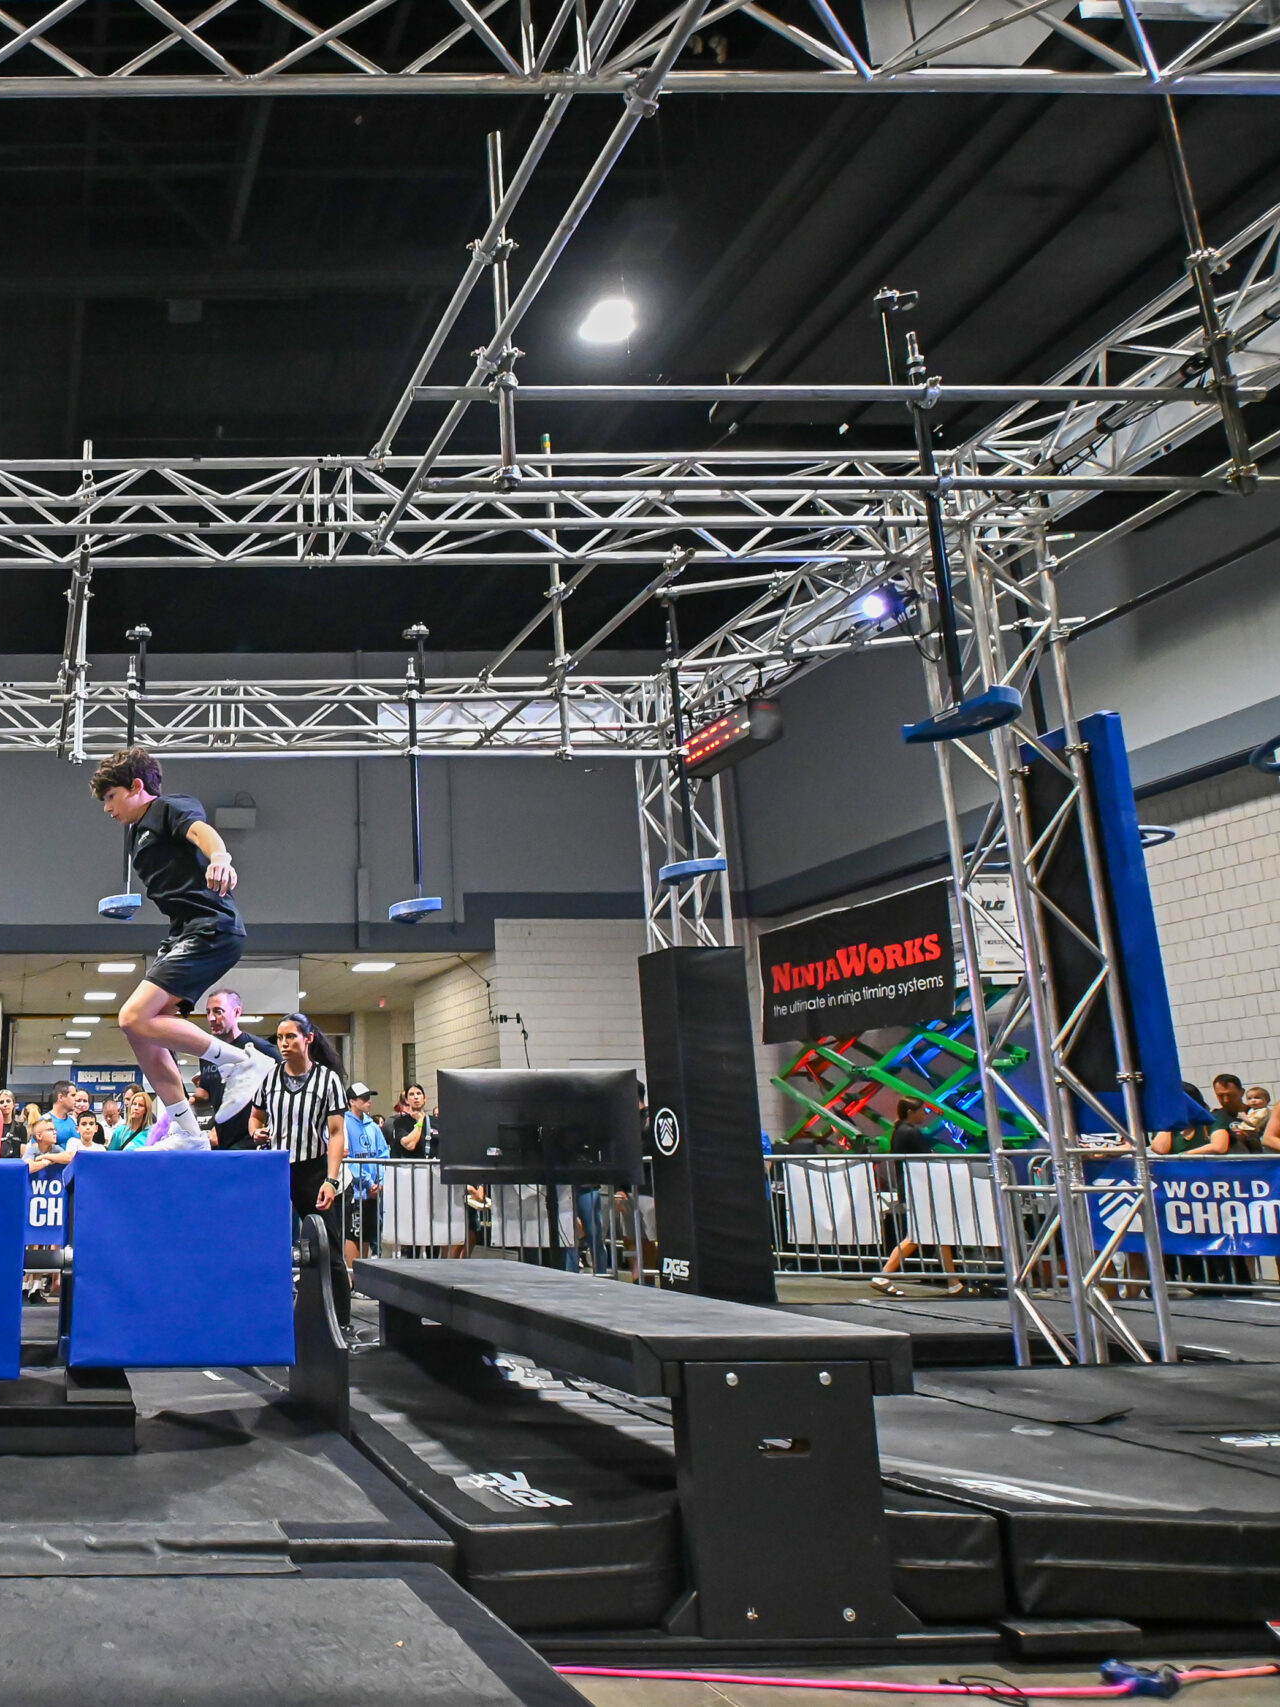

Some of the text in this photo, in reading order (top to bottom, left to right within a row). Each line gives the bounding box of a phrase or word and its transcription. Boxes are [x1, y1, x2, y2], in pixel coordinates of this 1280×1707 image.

[773, 974, 944, 1017] the ultimate in ninja timing systems
[1162, 1180, 1270, 1198] WORLD
[662, 1257, 690, 1278] DGS
